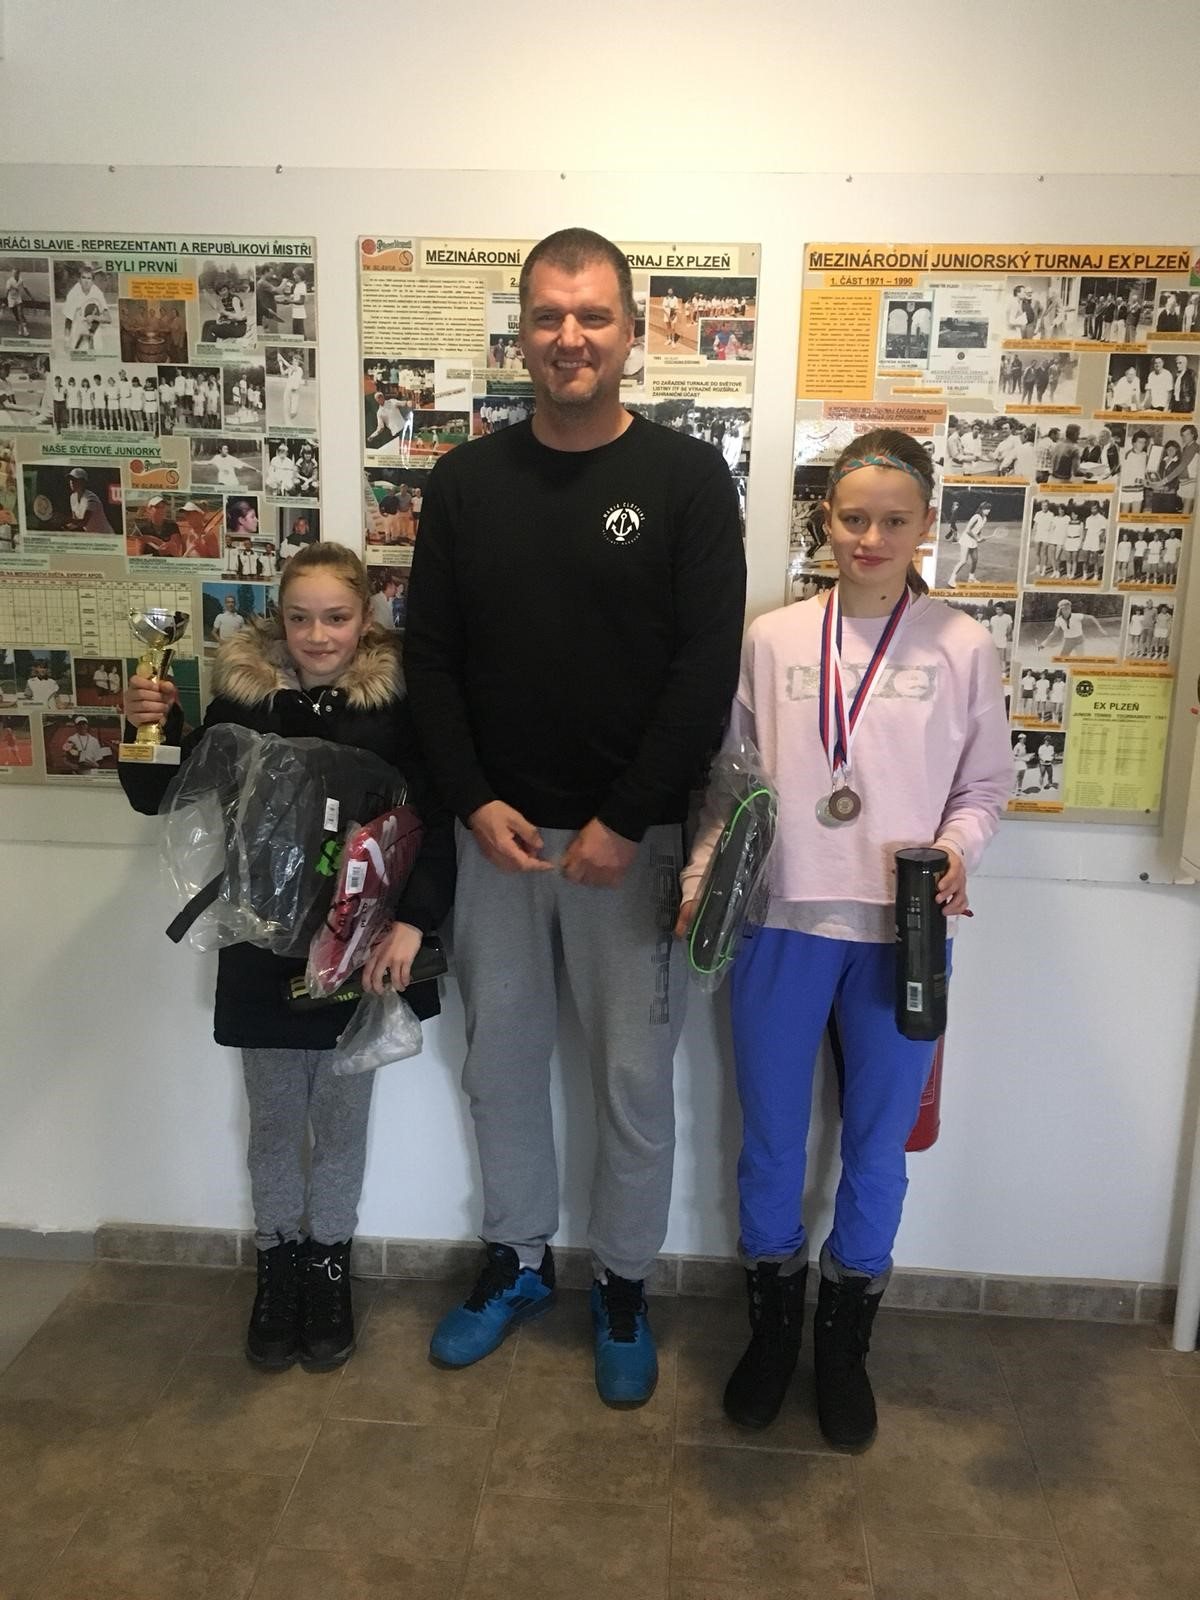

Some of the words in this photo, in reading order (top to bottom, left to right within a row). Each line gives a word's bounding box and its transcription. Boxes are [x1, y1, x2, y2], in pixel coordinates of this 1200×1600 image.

[33, 239, 75, 250] SLAVIE
[81, 239, 177, 252] REPREZENTANTI
[181, 242, 191, 252] A
[192, 241, 270, 255] REPUBLIKOVÍ
[273, 242, 312, 256] MISTŘI
[426, 247, 521, 265] MEZINÁRODNÍ
[627, 254, 663, 268] RNAJ
[666, 255, 685, 268] EX
[686, 252, 731, 268] PLZEŇ
[809, 249, 929, 268] MEZINÁRODNÍ
[930, 251, 1032, 269] JUNIORSKÝ
[1034, 254, 1103, 269] TURNAJ
[1107, 255, 1132, 269] EX
[1133, 251, 1191, 269] PLZEŇ
[105, 260, 136, 272] BYLI
[138, 258, 179, 273] PRVNÍ
[830, 277, 840, 286] 1.
[839, 275, 863, 286] ČÁST
[865, 277, 885, 286] 1971
[894, 277, 914, 287] 1990
[42, 443, 67, 455] NAŠE
[70, 444, 114, 457] SVĚTOVÉ
[114, 446, 162, 458] JUNIORKY
[1093, 701, 1107, 711] EX
[1109, 701, 1140, 712] PLZEŇ
